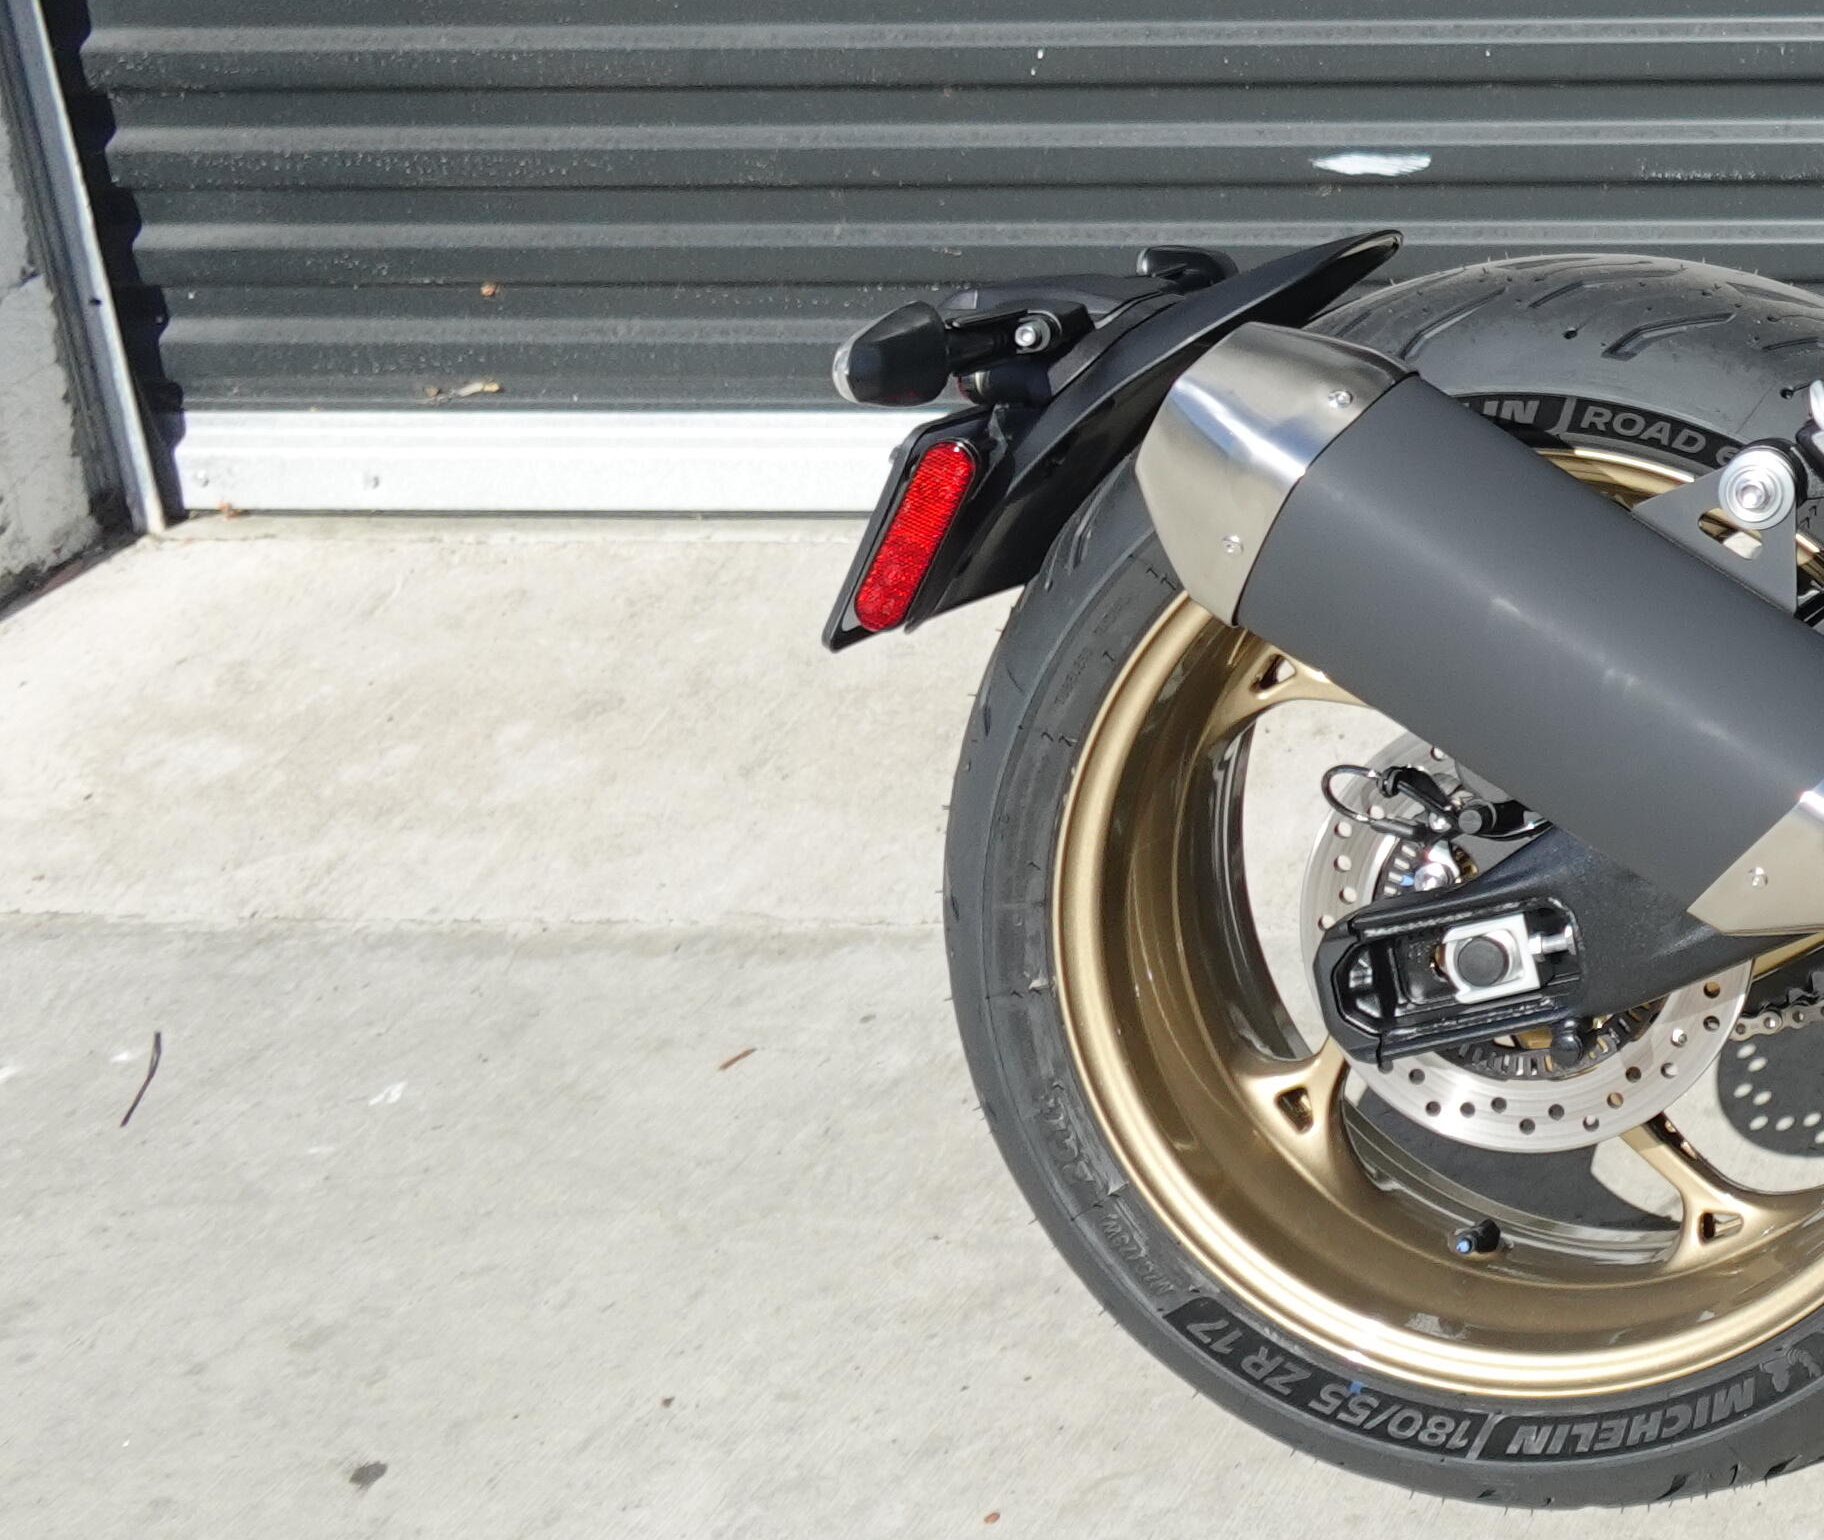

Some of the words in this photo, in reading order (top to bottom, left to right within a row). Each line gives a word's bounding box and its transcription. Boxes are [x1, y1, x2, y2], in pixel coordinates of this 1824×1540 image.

[1579, 405, 1707, 455] ROAD
[1186, 1318, 1243, 1354] 17
[1240, 1345, 1311, 1396] ZR
[1308, 1382, 1472, 1450] 180/55
[1505, 1376, 1756, 1455] MICHELIN
